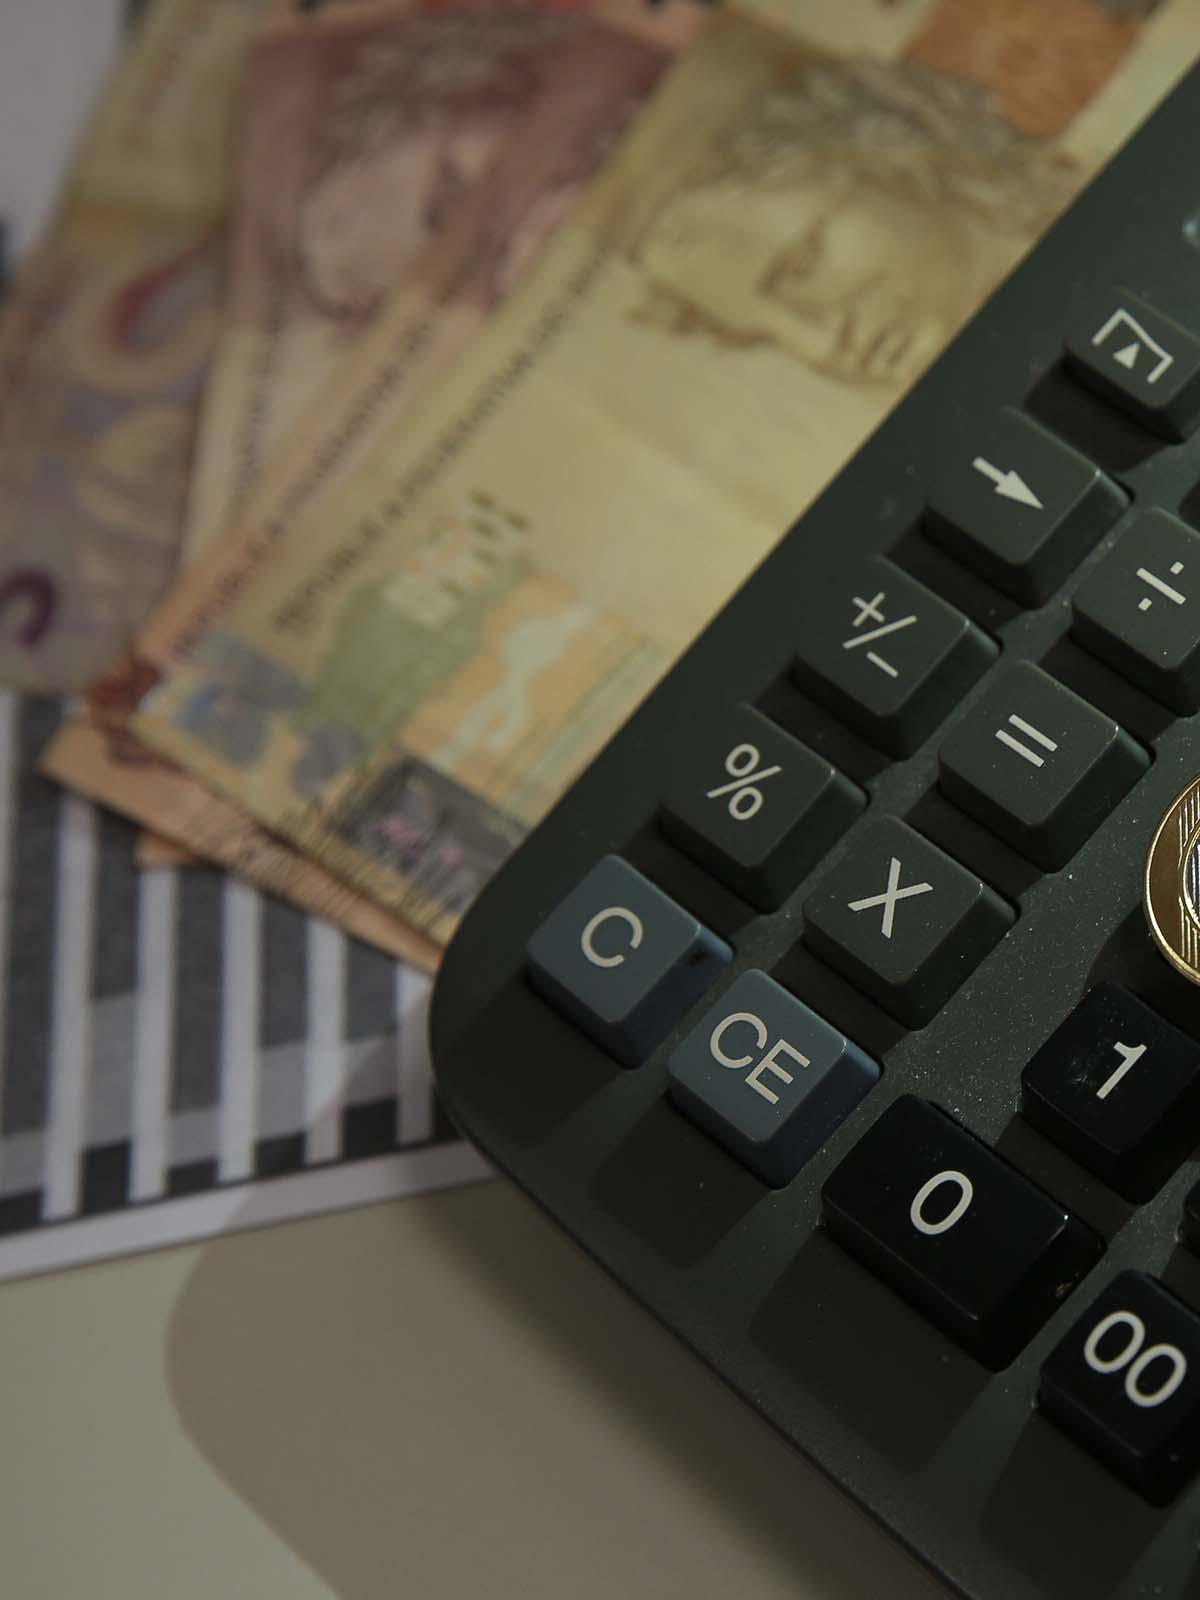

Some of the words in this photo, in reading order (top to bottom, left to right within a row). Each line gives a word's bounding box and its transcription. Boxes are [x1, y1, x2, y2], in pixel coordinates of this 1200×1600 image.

[580, 906, 644, 969] C
[709, 1011, 812, 1106] CE
[1096, 1041, 1148, 1100] 1
[909, 1169, 974, 1236] 0
[1083, 1310, 1188, 1408] 00
